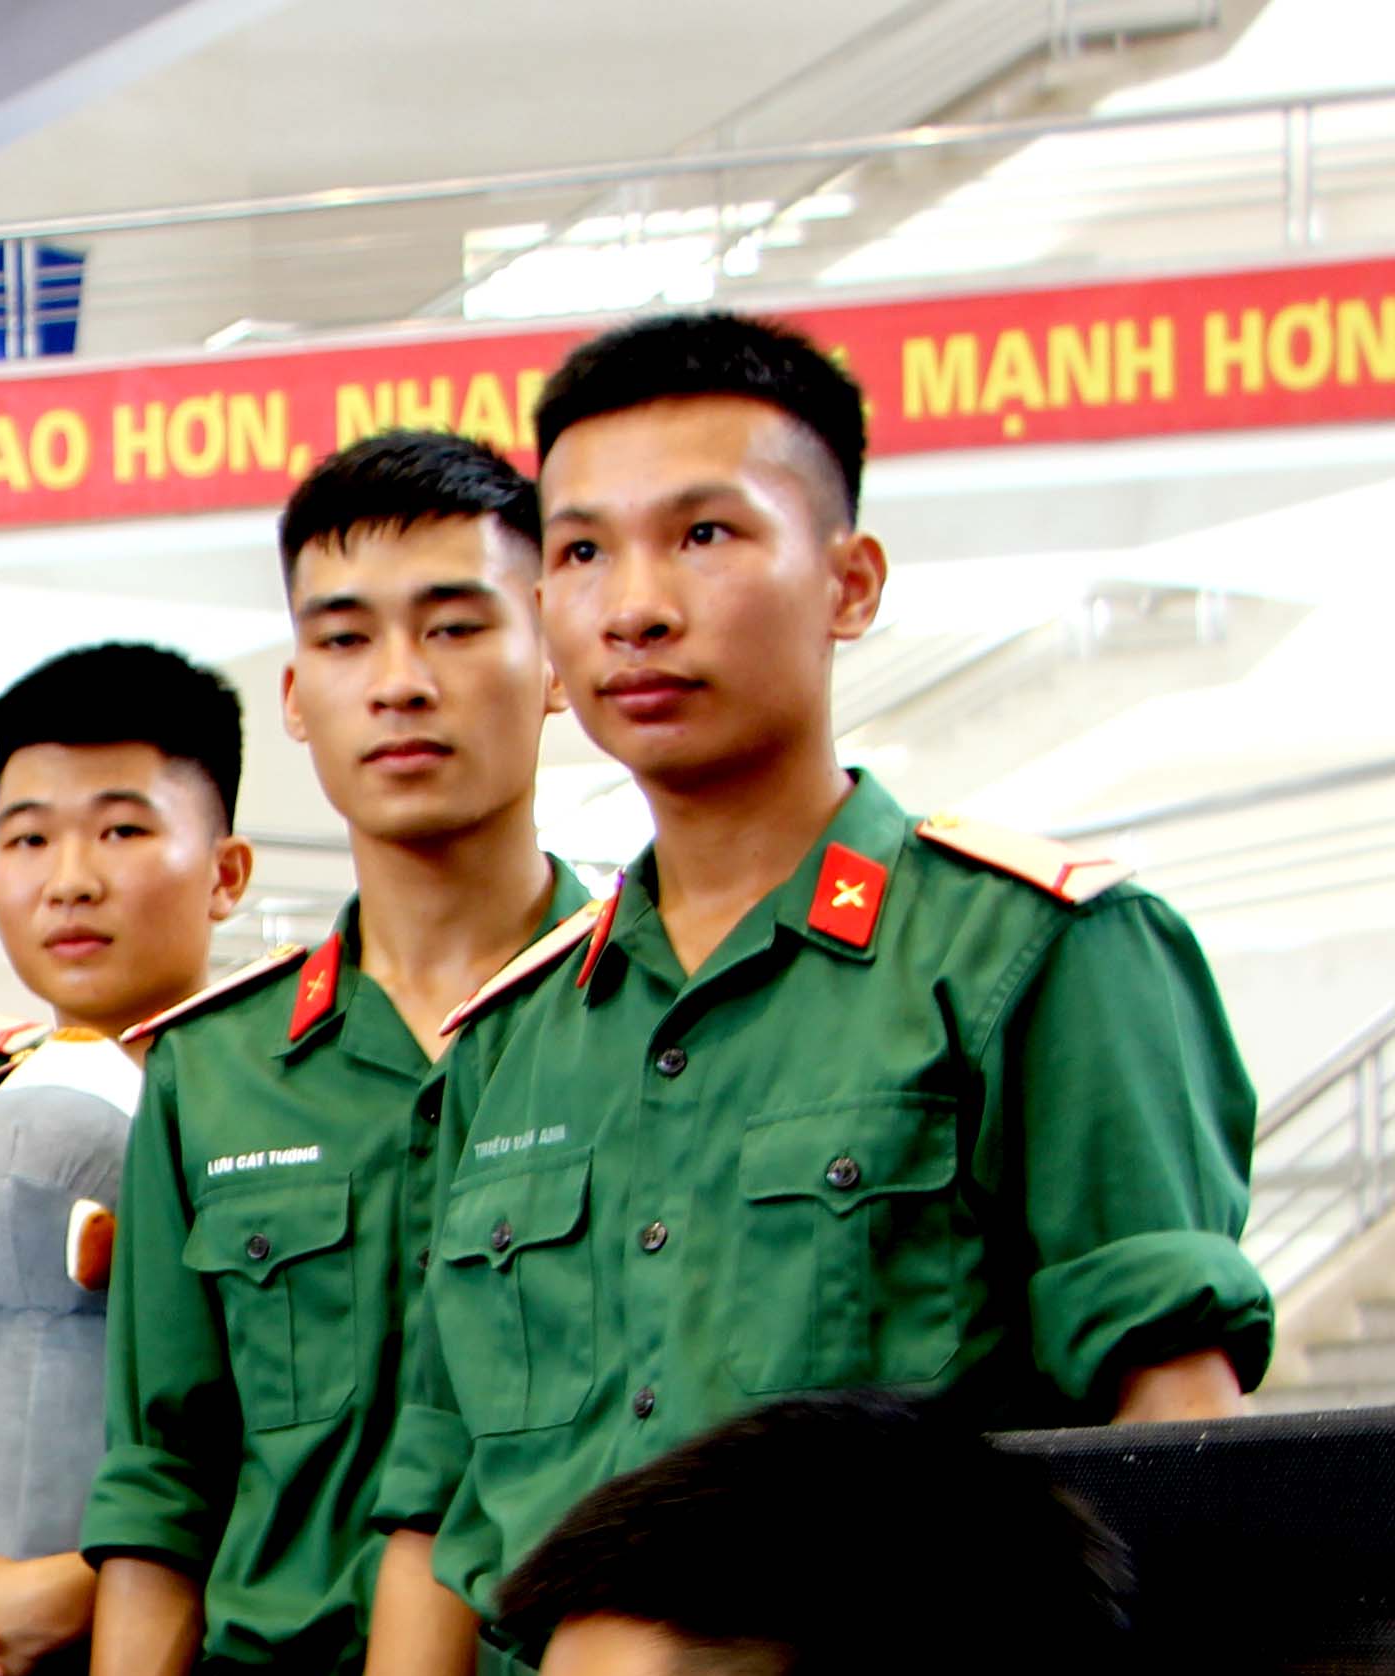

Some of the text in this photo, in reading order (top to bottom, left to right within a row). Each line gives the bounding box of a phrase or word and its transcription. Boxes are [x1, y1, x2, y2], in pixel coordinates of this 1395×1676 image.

[112, 389, 312, 478] HƠN,
[901, 316, 1174, 438] MẠNH
[1204, 294, 1395, 397] HƠN
